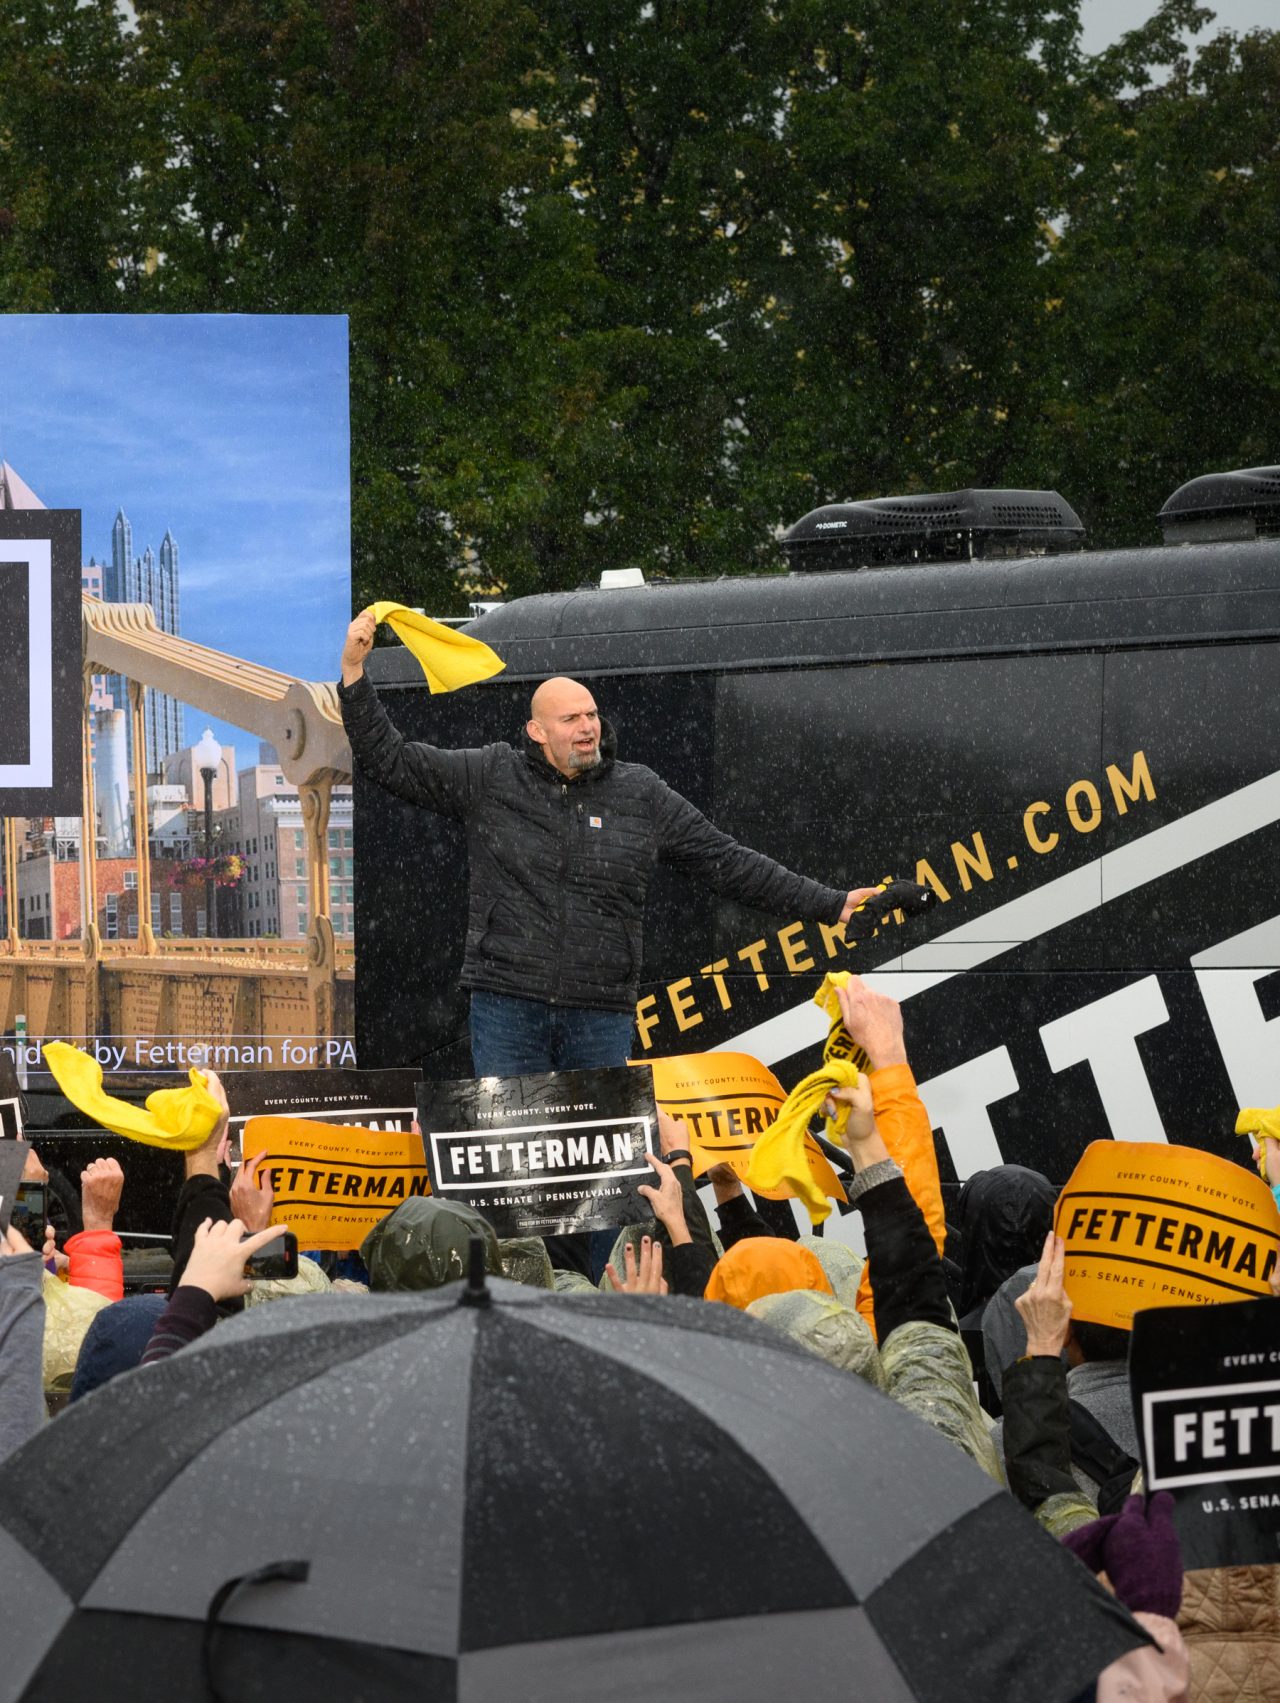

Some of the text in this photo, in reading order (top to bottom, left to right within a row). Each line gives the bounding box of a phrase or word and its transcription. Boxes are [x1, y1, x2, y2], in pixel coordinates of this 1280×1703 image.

[636, 751, 1158, 1051] FETTERAN.COM
[95, 1040, 126, 1070] by
[136, 1040, 273, 1065] Fetterman
[281, 1039, 317, 1064] for
[327, 1040, 356, 1064] PA
[675, 1080, 701, 1089] EVERY
[264, 1093, 371, 1106] EVERY COUNTY. EVERY VOTE.
[476, 1102, 597, 1120] EVERY COUNTY. EVERY VOTE.
[288, 1140, 315, 1148] EVERY
[317, 1144, 352, 1153] COUNTY.
[355, 1148, 381, 1157] EVERY
[449, 1132, 634, 1176] FETTERMAN
[470, 1186, 622, 1207] U.S. SENATE PENNSYLVANIA
[1117, 1171, 1259, 1212] EVERY COUNTY. EVERY VOTE.
[283, 1213, 319, 1221] SENATE
[1066, 1208, 1278, 1283] FETTERMAN
[1069, 1269, 1092, 1278] U.S.
[1097, 1271, 1145, 1288] SENATE
[1224, 1353, 1265, 1368] EVERY
[1202, 1500, 1236, 1514] U.S.
